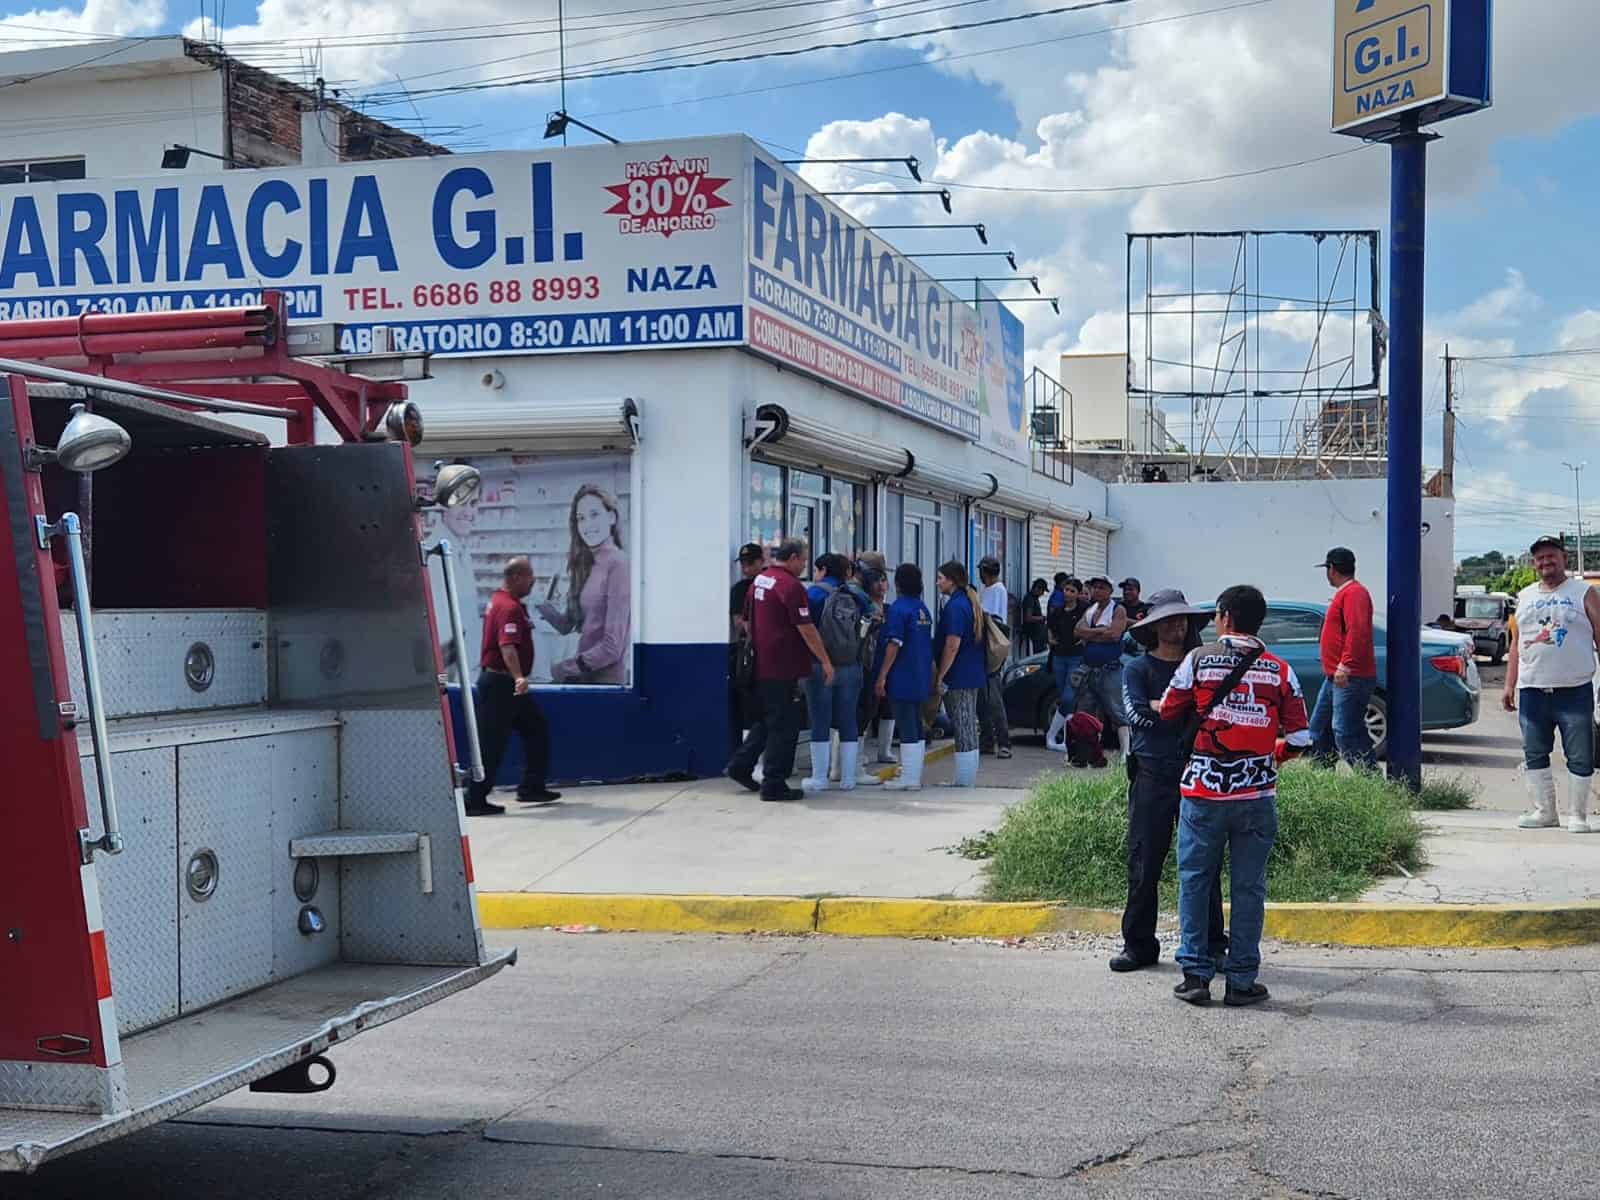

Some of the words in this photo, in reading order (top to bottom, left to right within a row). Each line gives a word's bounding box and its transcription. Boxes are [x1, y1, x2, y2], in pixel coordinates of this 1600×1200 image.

[1354, 25, 1420, 75] G.I.
[1356, 79, 1415, 115] NAZA
[625, 159, 680, 179] HASTA
[683, 157, 709, 175] UN
[627, 175, 708, 217] 80%
[432, 161, 584, 270] G.I.
[620, 218, 642, 235] DE
[644, 214, 716, 234] AHORRO
[754, 156, 921, 350] FARMACIA
[343, 287, 403, 311] TEL.
[412, 282, 479, 308] 6686
[489, 280, 522, 304] 88
[532, 275, 600, 302] 8993
[626, 264, 718, 294] NAZA
[76, 296, 128, 316] 7:30
[135, 294, 173, 314] AM
[754, 271, 812, 322] HORARIO
[813, 303, 837, 335] 7:30
[510, 319, 564, 348] 8:30
[571, 317, 611, 345] AM
[619, 313, 690, 343] 11:00
[695, 311, 736, 340] AM
[753, 315, 817, 366] CONSULTORIO
